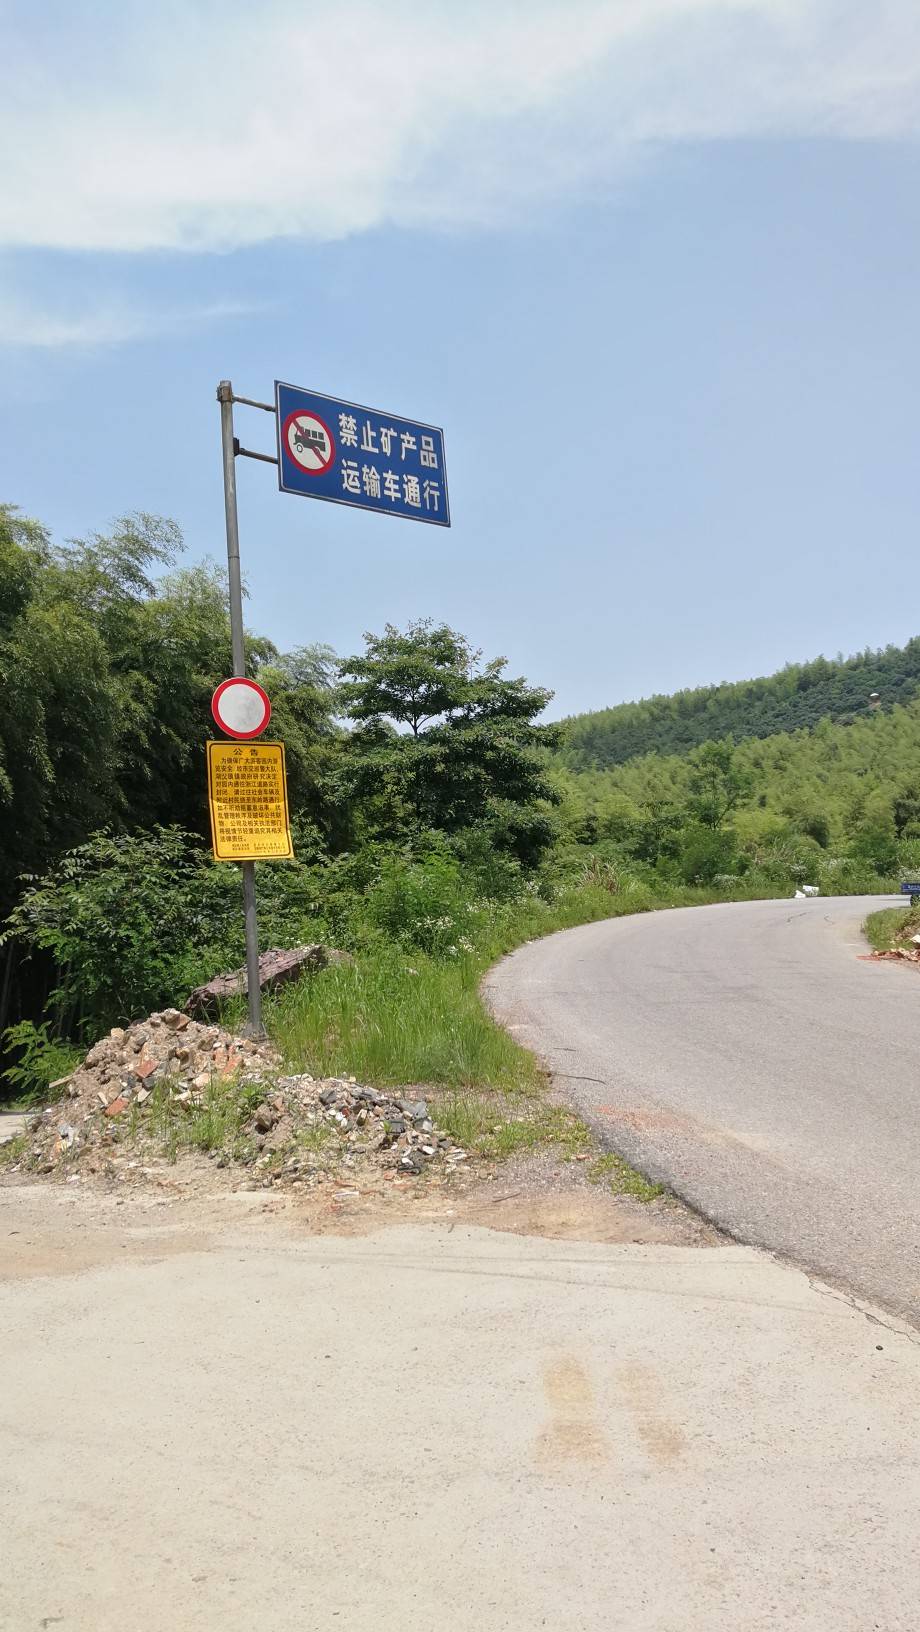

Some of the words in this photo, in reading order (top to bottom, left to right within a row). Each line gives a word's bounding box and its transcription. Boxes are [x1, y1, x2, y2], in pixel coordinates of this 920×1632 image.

[338, 413, 438, 469] 禁止矿产品
[341, 458, 440, 512] 运输车通行
